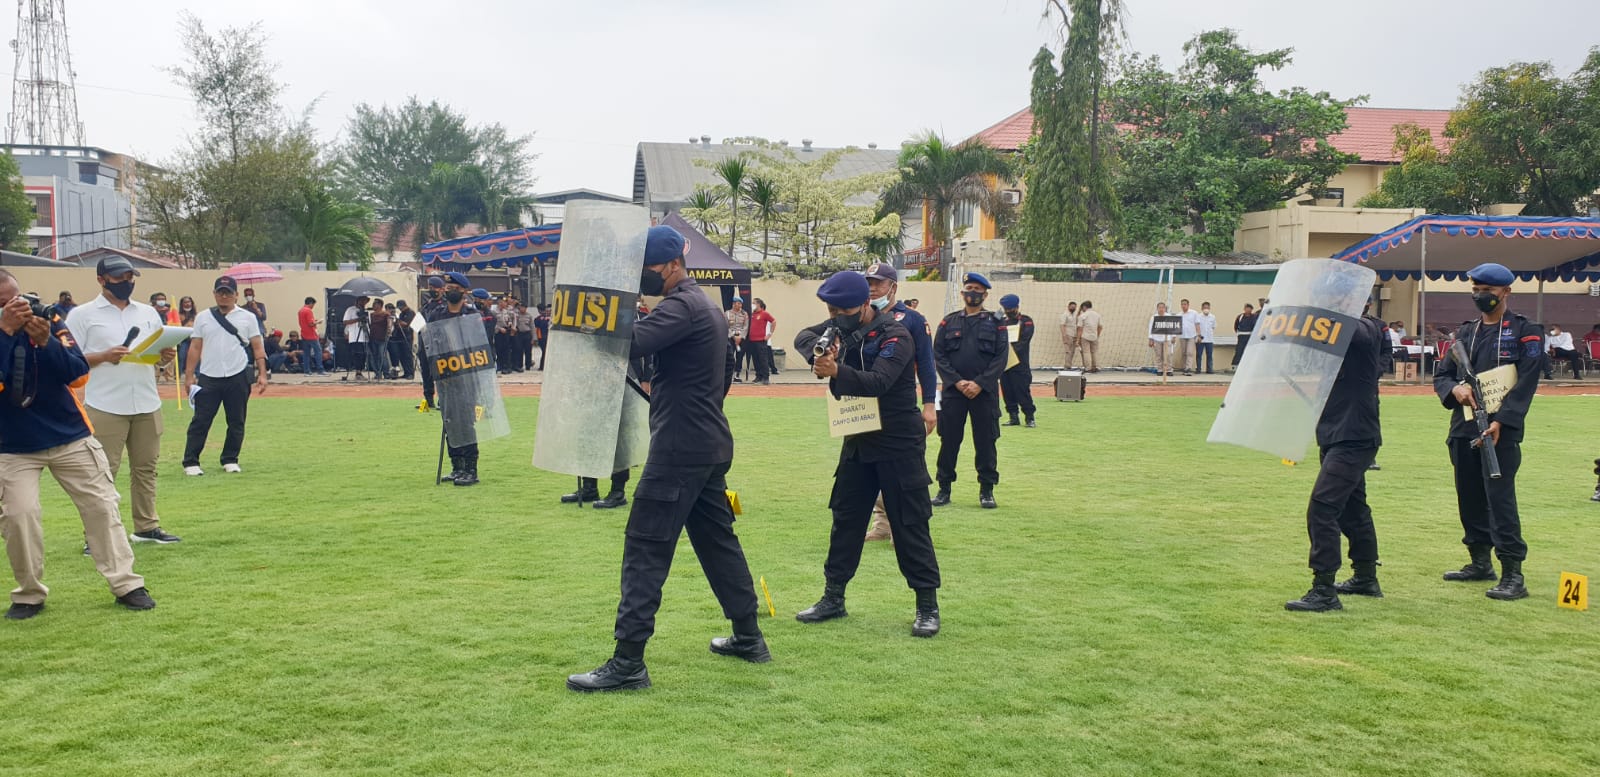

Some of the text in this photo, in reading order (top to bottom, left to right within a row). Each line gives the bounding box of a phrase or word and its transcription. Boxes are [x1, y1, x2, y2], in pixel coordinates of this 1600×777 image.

[689, 269, 734, 280] AMAPTA
[551, 289, 619, 332] OLISI
[1258, 313, 1342, 345] POLISI
[436, 350, 489, 375] POLISI
[1481, 378, 1499, 389] AKSI
[1482, 385, 1509, 398] ARAKA
[1562, 579, 1581, 605] 24
